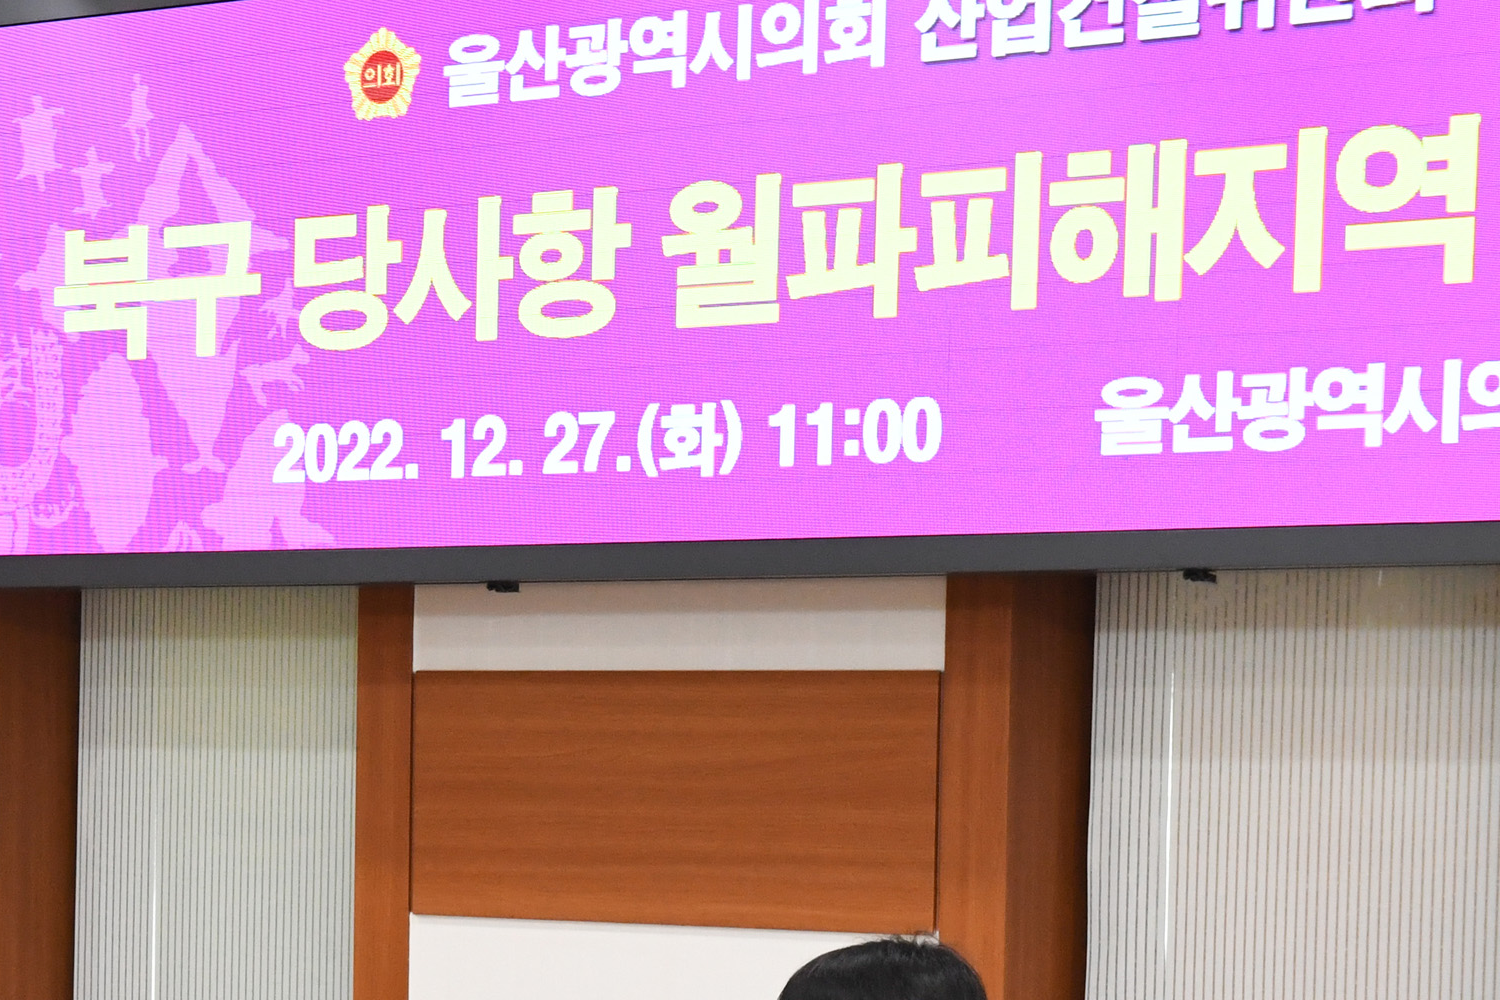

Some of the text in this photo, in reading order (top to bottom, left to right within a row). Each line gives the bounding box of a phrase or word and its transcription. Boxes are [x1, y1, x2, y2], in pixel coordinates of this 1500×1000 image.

[363, 61, 401, 88] 의회
[444, 1, 886, 108] 울산광역시의회
[53, 113, 1481, 360] 북구 당사항 월파피해지역
[272, 396, 943, 483] 2022. 12. 27.(화) 11:00
